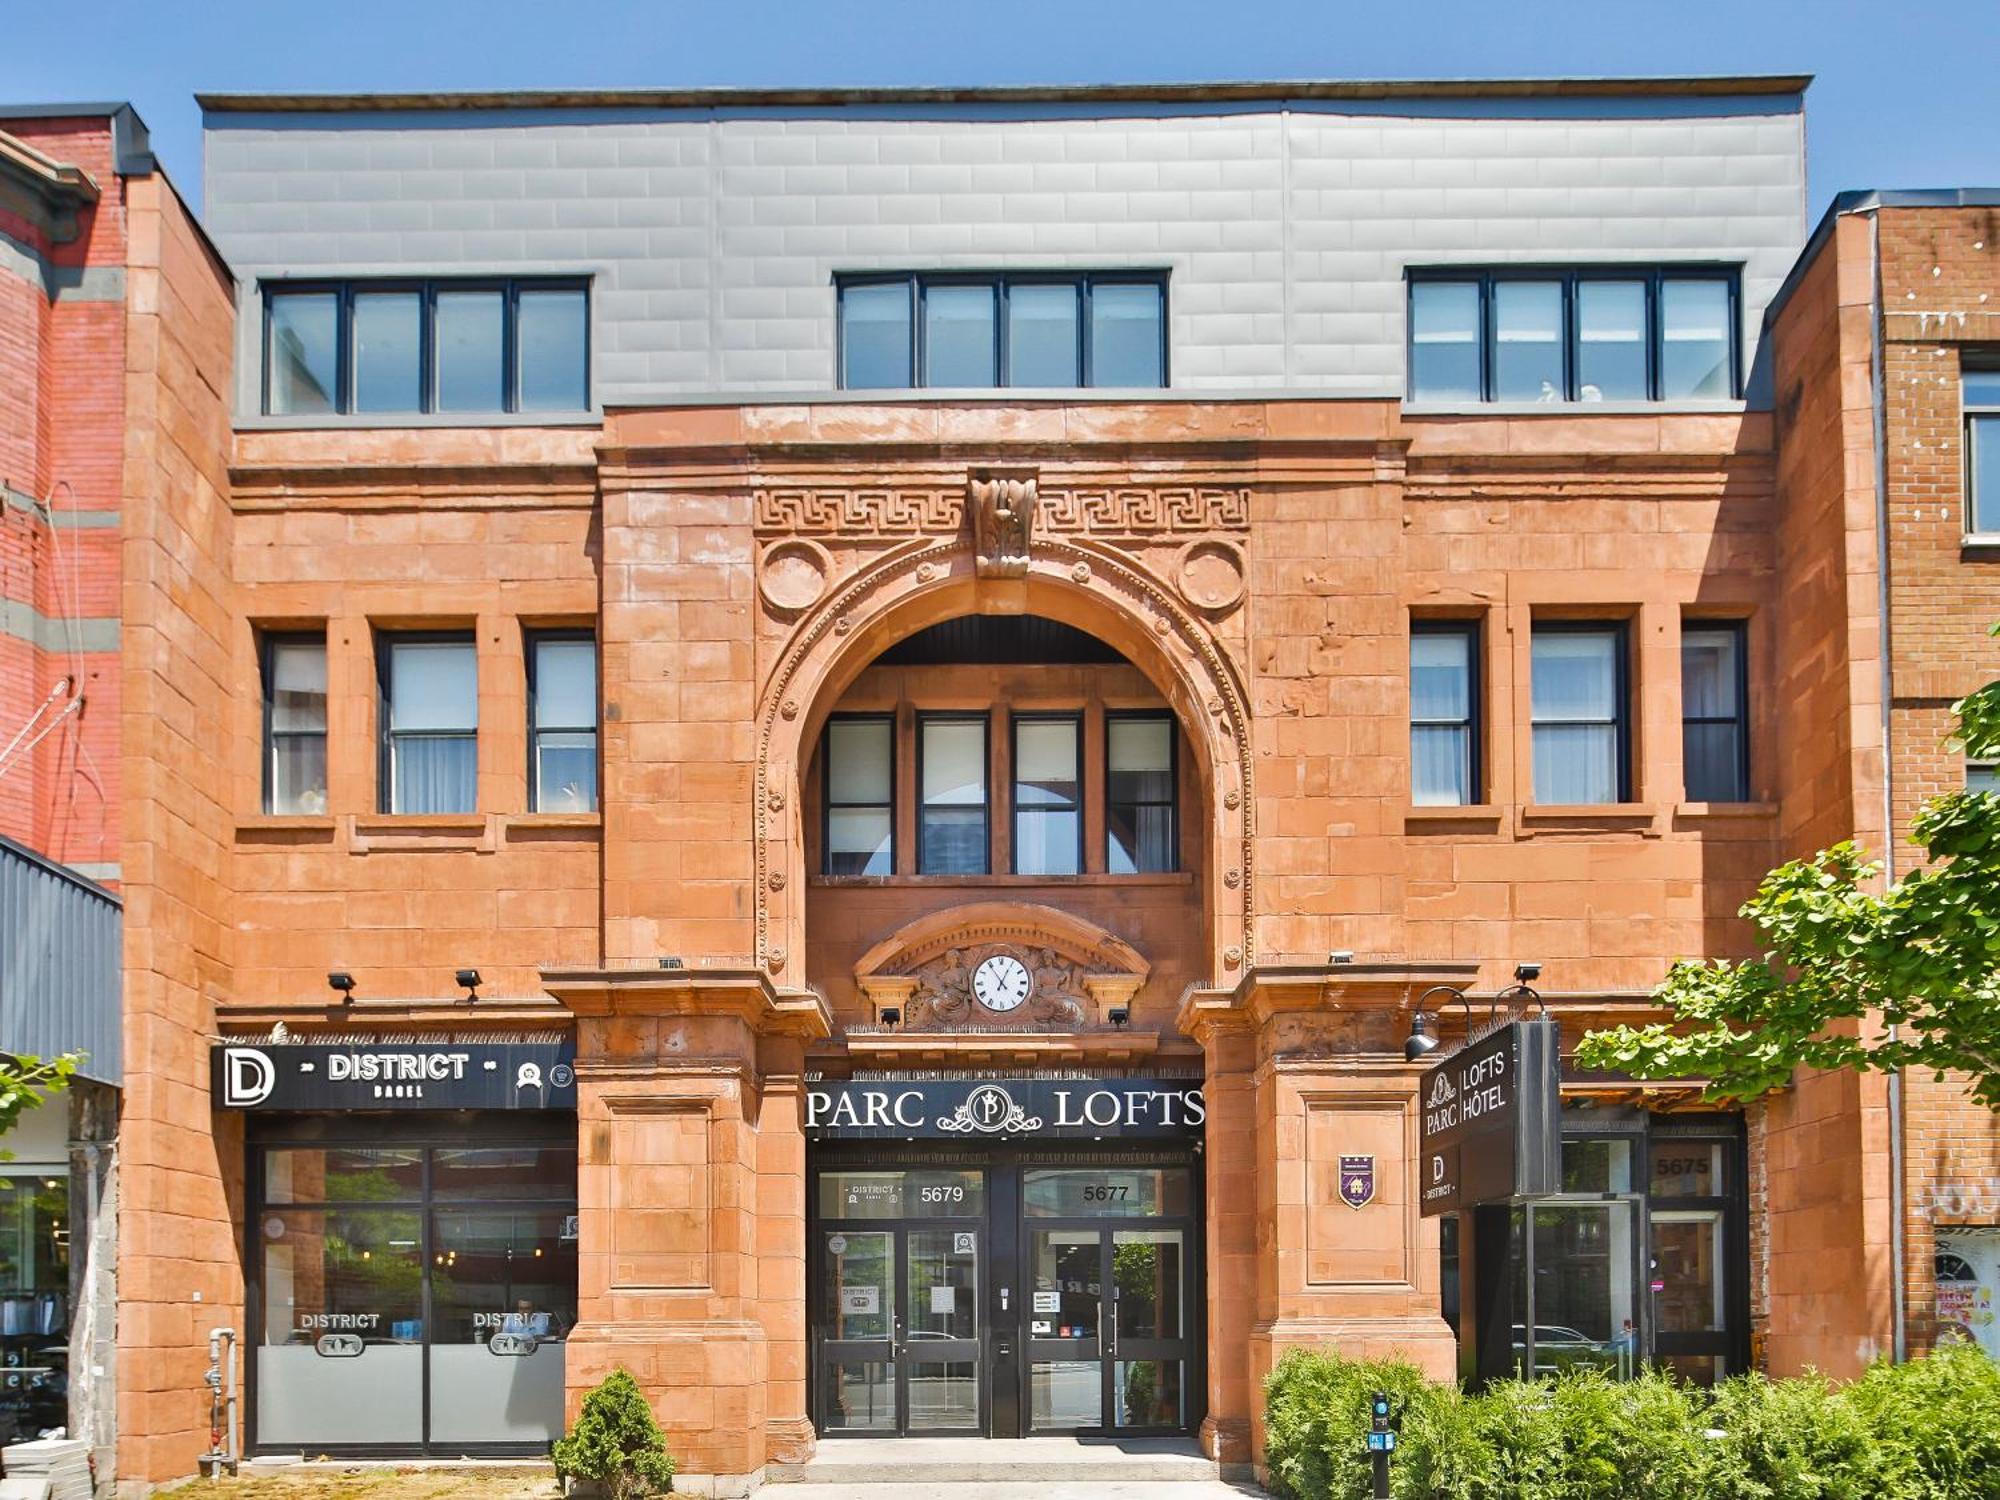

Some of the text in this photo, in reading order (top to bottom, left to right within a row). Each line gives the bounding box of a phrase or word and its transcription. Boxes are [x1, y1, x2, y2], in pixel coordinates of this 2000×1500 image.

[224, 1048, 275, 1106] D
[328, 1053, 469, 1081] DISTRICT
[1463, 1051, 1504, 1091] LOFTS
[804, 1091, 925, 1128] PARC
[1053, 1090, 1206, 1126] LOFTS
[1463, 1084, 1507, 1121] HÔTEL
[1427, 1104, 1457, 1135] PARC
[1432, 1155, 1444, 1184] D
[1657, 1159, 1708, 1174] 5675
[852, 1185, 894, 1194] DISTRICT
[921, 1187, 963, 1202] 5679
[1083, 1186, 1129, 1201] 5677
[301, 1314, 380, 1329] DISTRICT
[473, 1312, 553, 1328] DISTRICT
